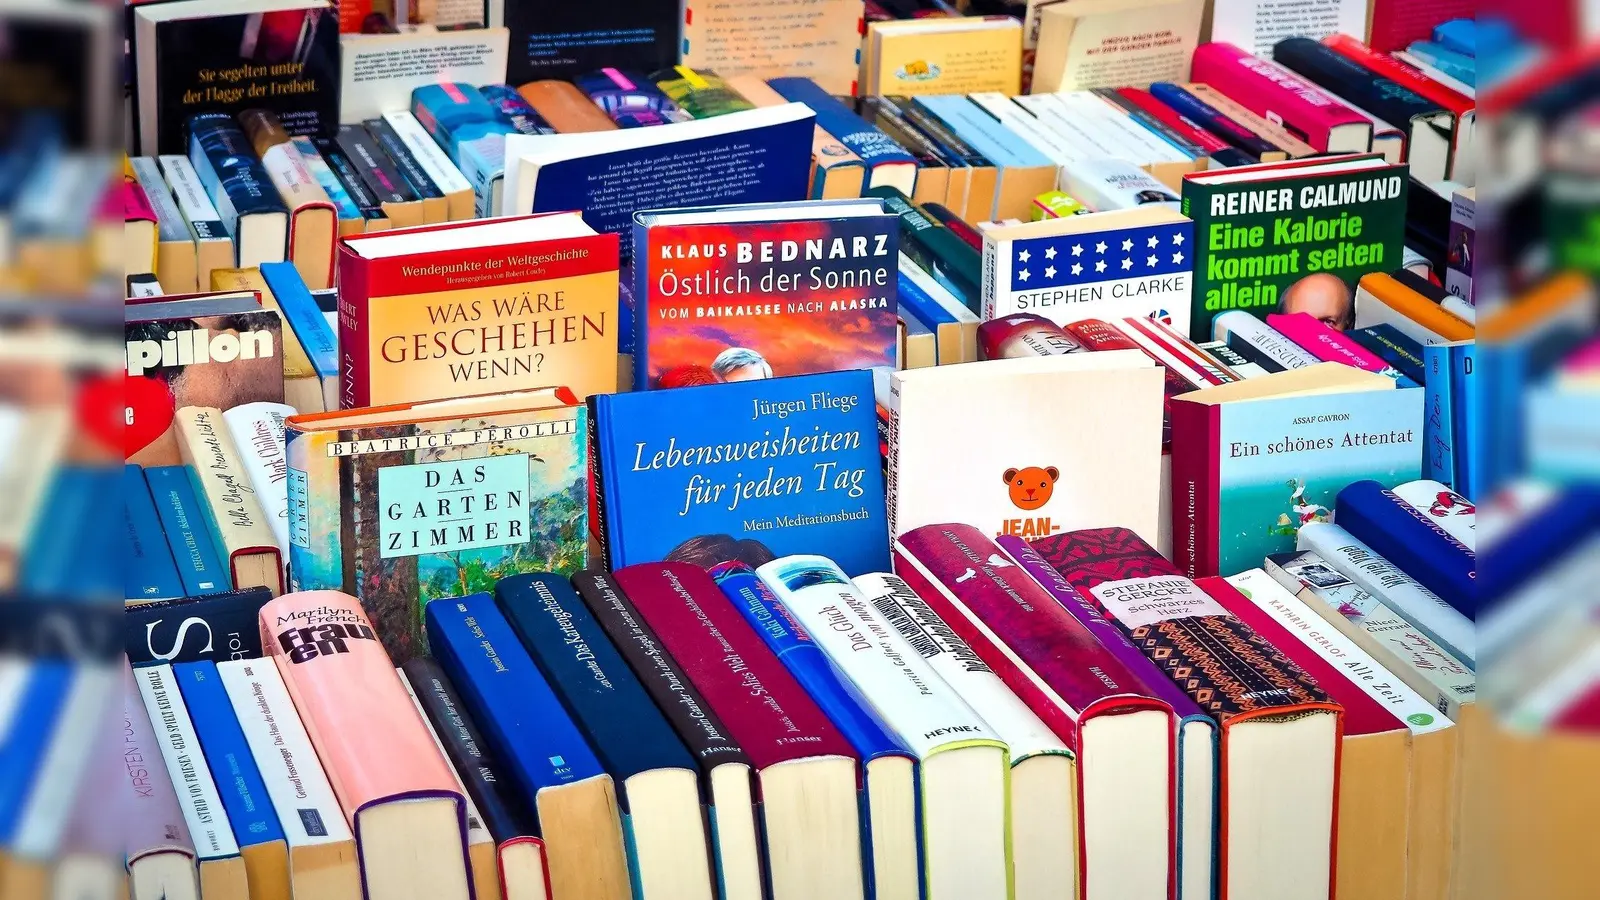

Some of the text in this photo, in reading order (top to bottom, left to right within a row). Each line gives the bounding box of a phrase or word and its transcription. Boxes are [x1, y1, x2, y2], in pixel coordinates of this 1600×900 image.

[198, 62, 304, 82] Sie segelten unter
[183, 89, 204, 103] der
[248, 82, 267, 97] der
[1211, 176, 1401, 216] REINER CALMUND
[1209, 212, 1362, 250] Eine Kalorie
[402, 248, 589, 277] Wendepunkte der Weltgeschichte
[661, 234, 888, 264] KLAUS BEDNARZ
[1207, 242, 1383, 281] kommt selten
[493, 272, 504, 280] von
[505, 269, 524, 279] Robert
[659, 266, 888, 297] Östlich der Sonne
[1017, 277, 1185, 309] STEPHEN CLARKE
[1206, 280, 1277, 311] allein
[427, 290, 565, 325] WAS WÄRE
[660, 297, 888, 319] VOM BAIKALSEE NACH ALASKA
[381, 311, 606, 364] GESCHEHEN
[448, 353, 544, 382] WENN?
[1221, 346, 1247, 366] PIPER
[752, 392, 858, 420] Jürgen Fliege
[1292, 413, 1350, 425] ASSAF GAVRON
[252, 419, 280, 458] Childress
[333, 421, 571, 455] BEATRICE FEROLLI
[632, 426, 860, 472] Lebensweisheiten
[1230, 429, 1413, 458] Ein schönes Attentat
[425, 465, 486, 488] DAS
[679, 461, 865, 516] für jeden Tag
[298, 475, 307, 543] ZIMMER
[388, 490, 522, 521] GARTEN
[1187, 481, 1195, 521] Attentat
[743, 508, 870, 532] Mein Meditationsbuch
[997, 517, 1060, 536] JEAN-
[389, 520, 522, 550] ZIMMER
[1187, 523, 1195, 562] schönes
[1102, 579, 1190, 598] STEFANIE
[1118, 587, 1192, 602] GERCKE
[277, 607, 353, 626] Marilyn
[307, 615, 367, 625] French
[531, 580, 585, 645] Kartengeheimnis
[739, 587, 789, 639] Kuki Gallmann
[838, 592, 874, 627] morgen
[1128, 599, 1204, 614] Schwarzes
[1156, 606, 1192, 616] Herz
[277, 623, 377, 654] Frau
[817, 605, 873, 652] Das Glück
[1366, 623, 1411, 633] Gerrard
[290, 640, 350, 664] en
[575, 643, 594, 661] Das
[722, 653, 749, 673] Welt
[1269, 600, 1405, 704] KATHRIN GERLOF Alle Zeit
[147, 670, 164, 690] ROLLE
[663, 672, 683, 692] Durch
[741, 671, 769, 697] Sofies
[902, 667, 933, 696] Patricia
[1089, 666, 1119, 689] HANSER
[155, 687, 173, 711] KEINE
[680, 693, 706, 718] Gaarder
[161, 709, 182, 734] SPIELT
[702, 719, 727, 741] Jostein
[924, 725, 973, 740] HEYNE
[173, 729, 187, 751] GELD
[274, 736, 285, 746] Das
[124, 747, 154, 798] KIRSTEN
[177, 754, 198, 783] FRIESEN
[186, 779, 201, 797] VON
[191, 796, 213, 824] ASTRID
